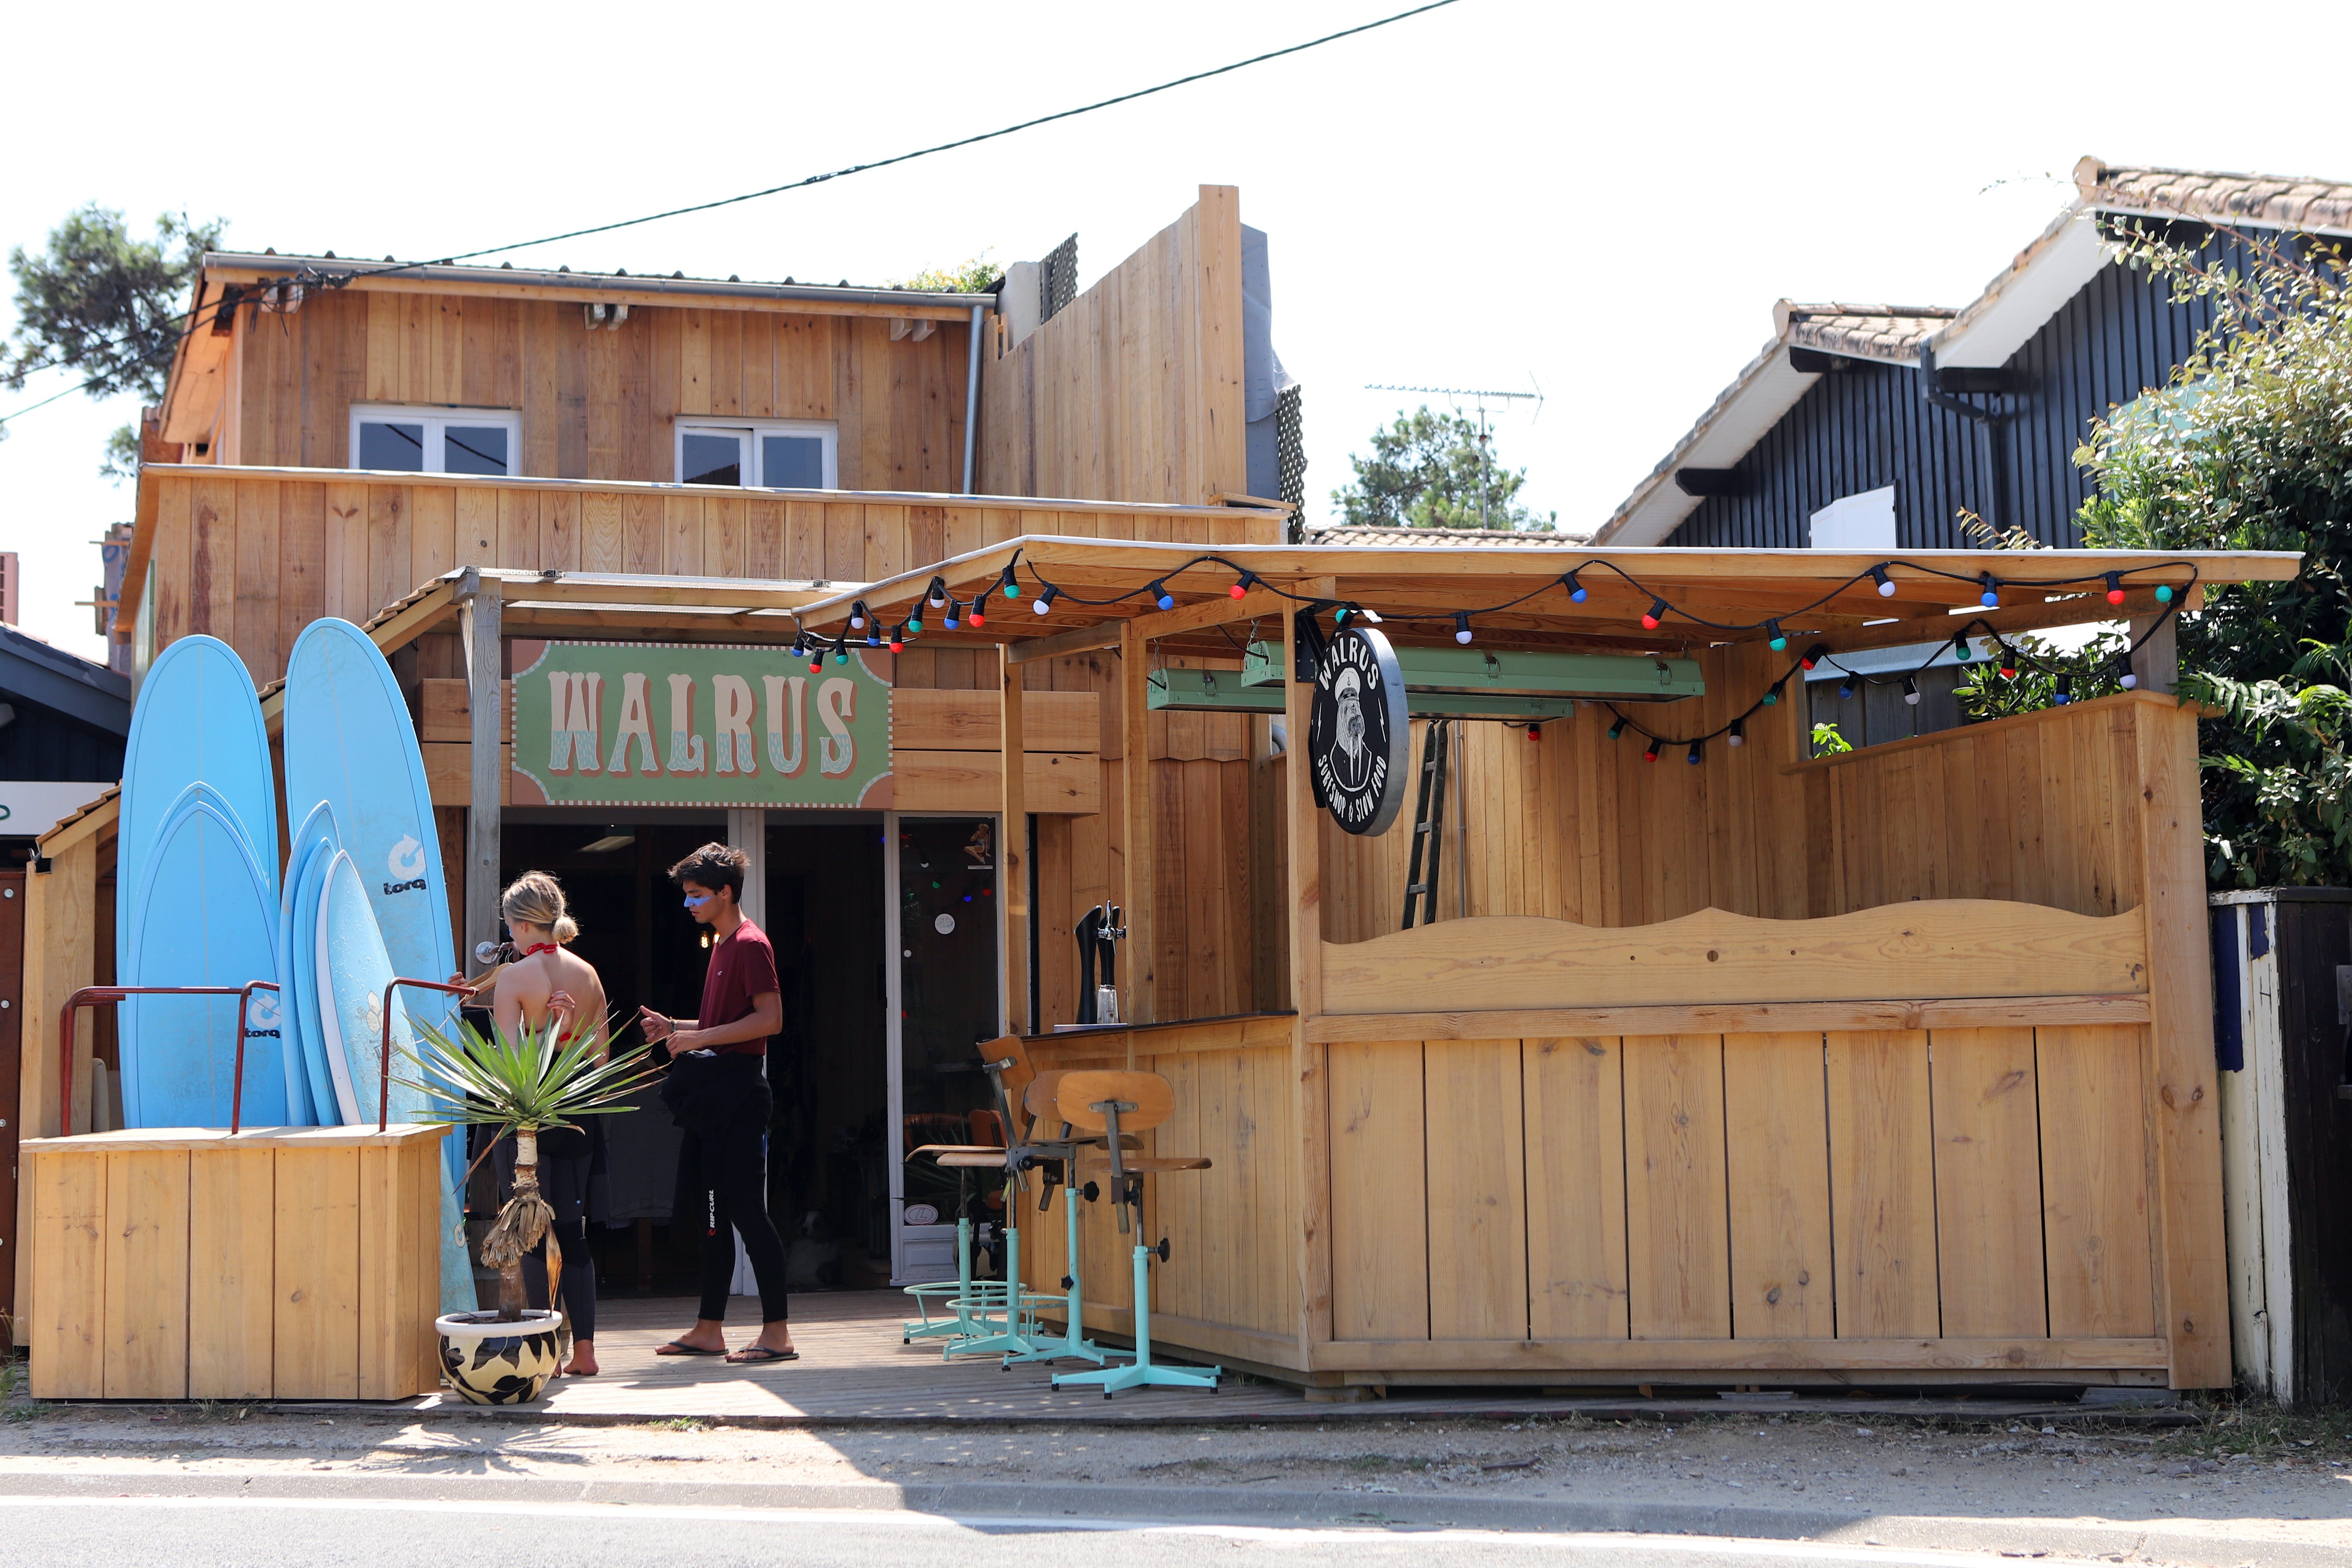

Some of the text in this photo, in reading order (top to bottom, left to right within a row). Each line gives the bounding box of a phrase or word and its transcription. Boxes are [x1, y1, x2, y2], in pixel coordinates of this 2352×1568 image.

[1319, 637, 1379, 691] WALRUS
[547, 671, 857, 779] WALRUS
[1318, 754, 1386, 823] SURFSHOP & SLOW FOOD
[384, 879, 426, 895] torq
[244, 1028, 280, 1039] torq
